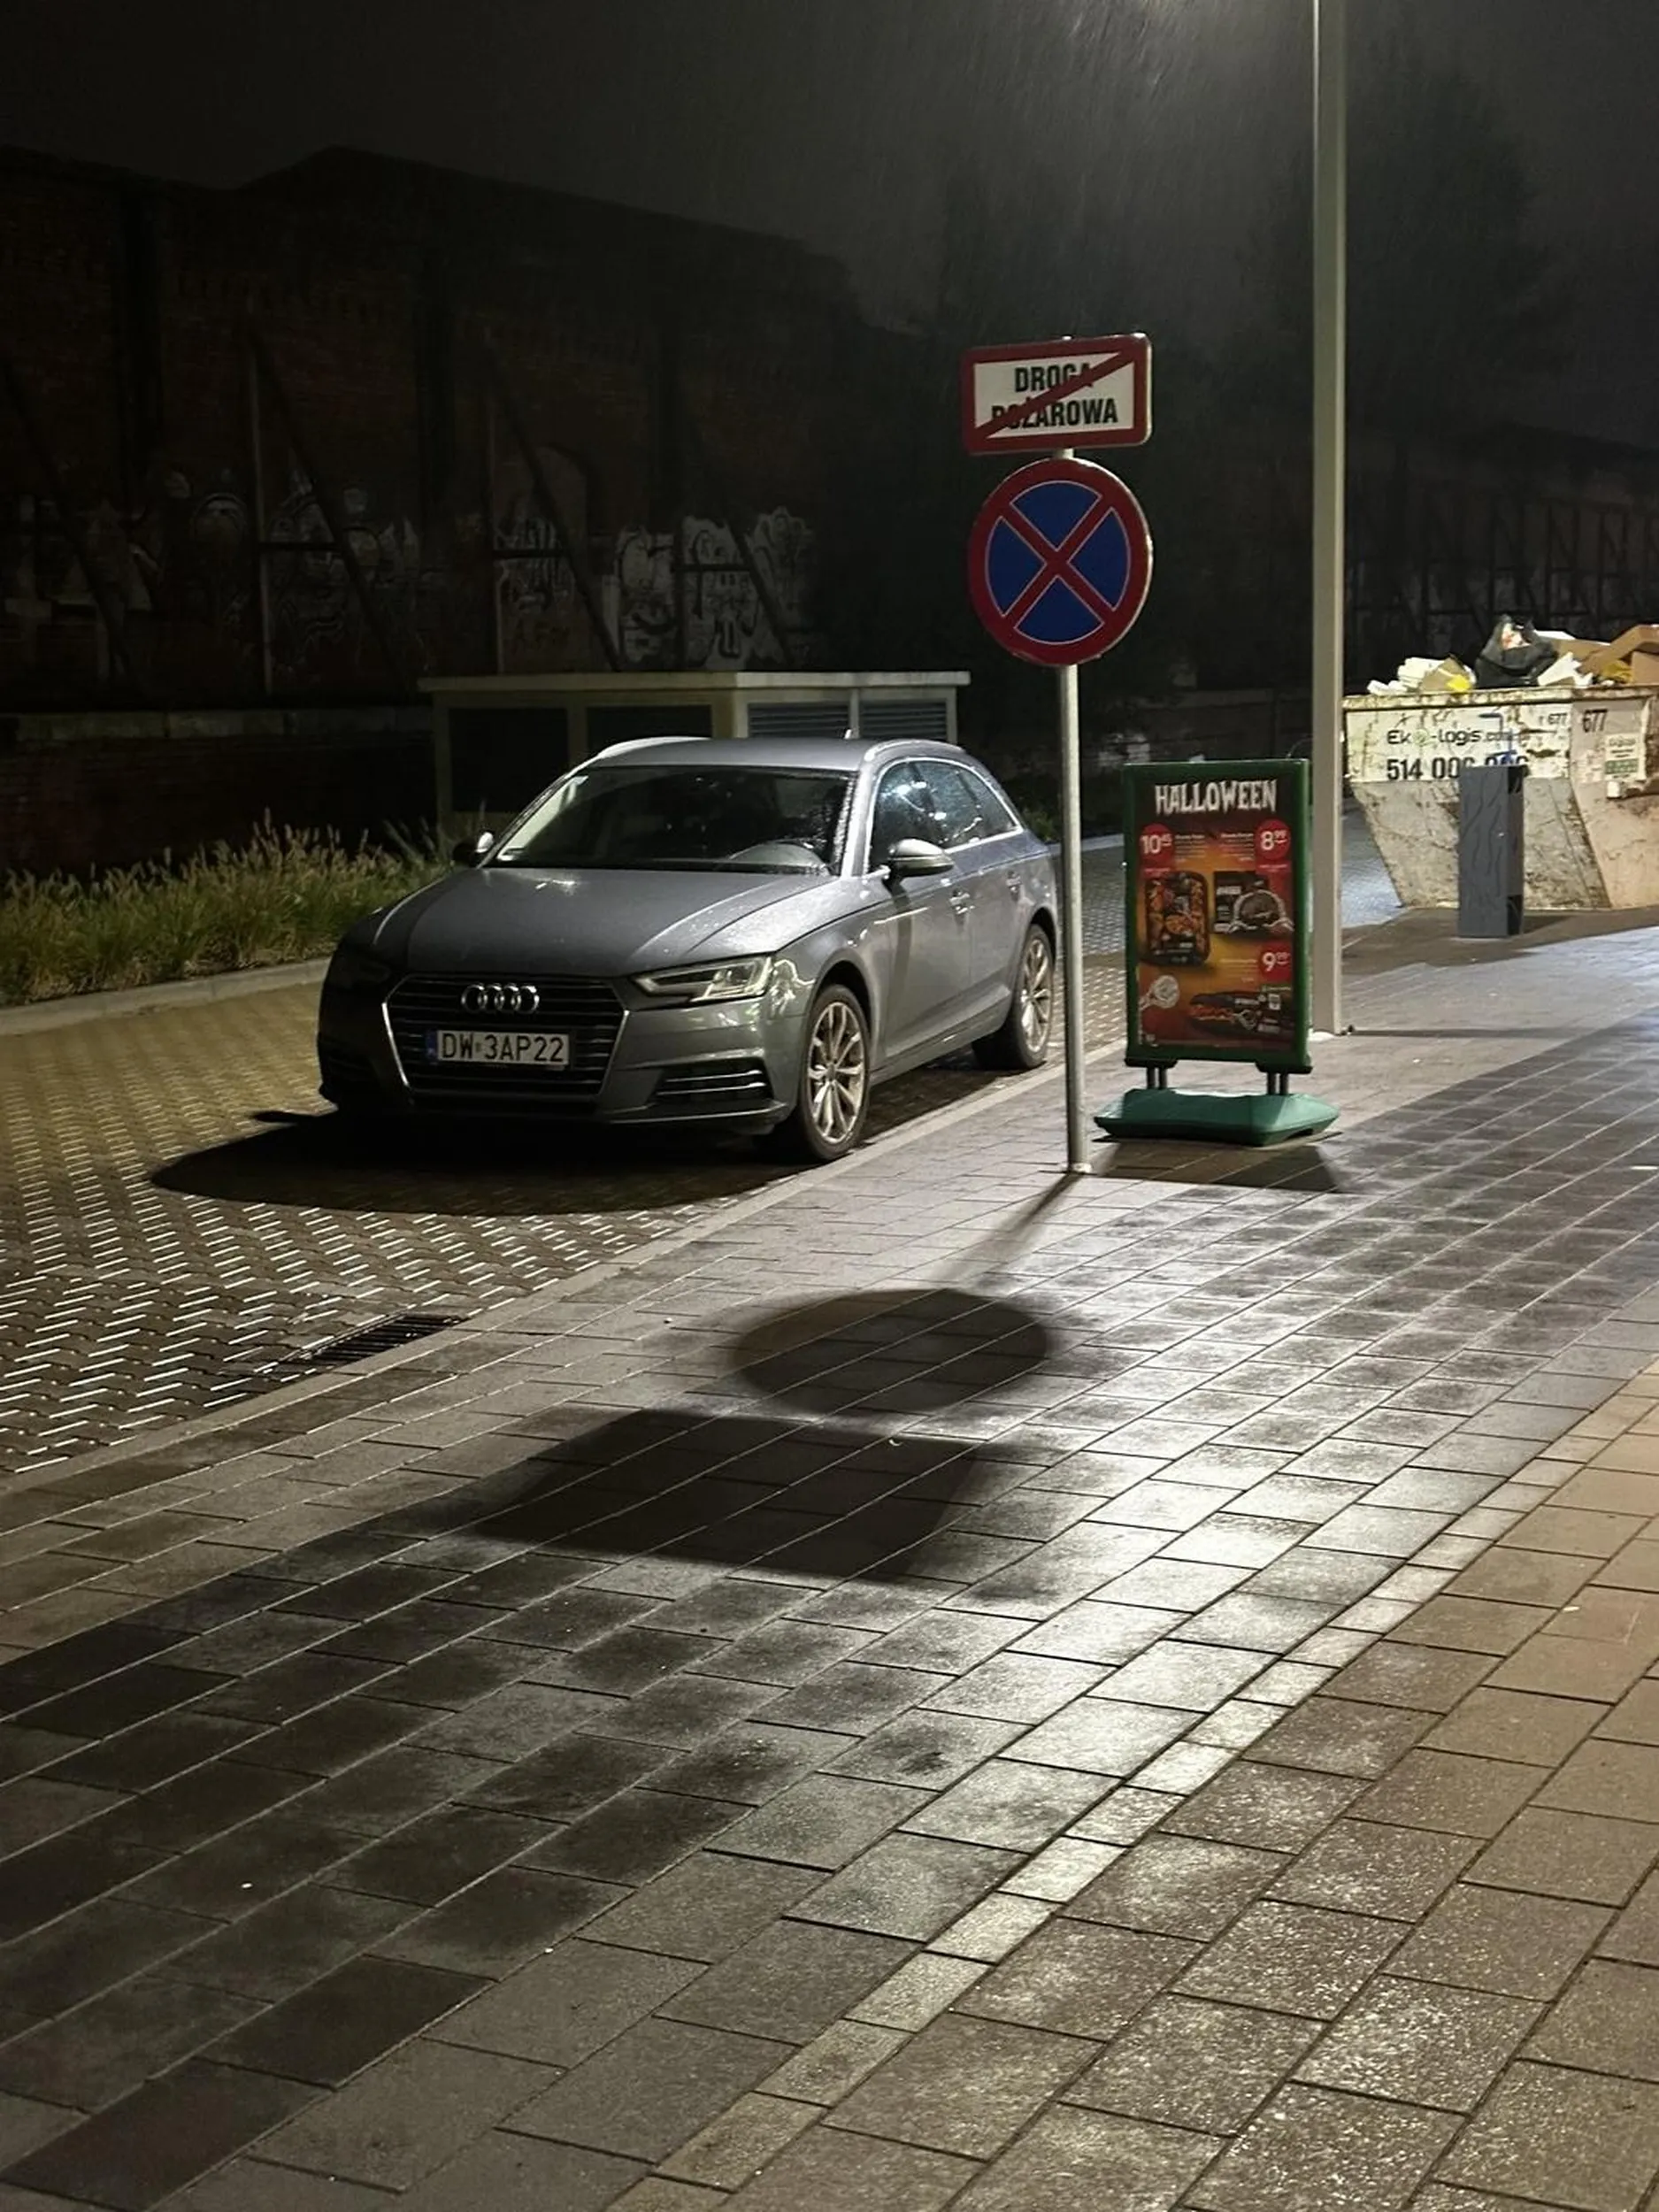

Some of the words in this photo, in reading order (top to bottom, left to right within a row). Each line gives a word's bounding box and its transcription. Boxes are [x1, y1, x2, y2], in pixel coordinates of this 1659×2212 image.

[1579, 709, 1608, 733] 677
[1386, 758, 1423, 780] 514
[1155, 779, 1277, 817] HALLOWEEN
[442, 1033, 474, 1059] DW
[485, 1034, 564, 1062] 3AP22
